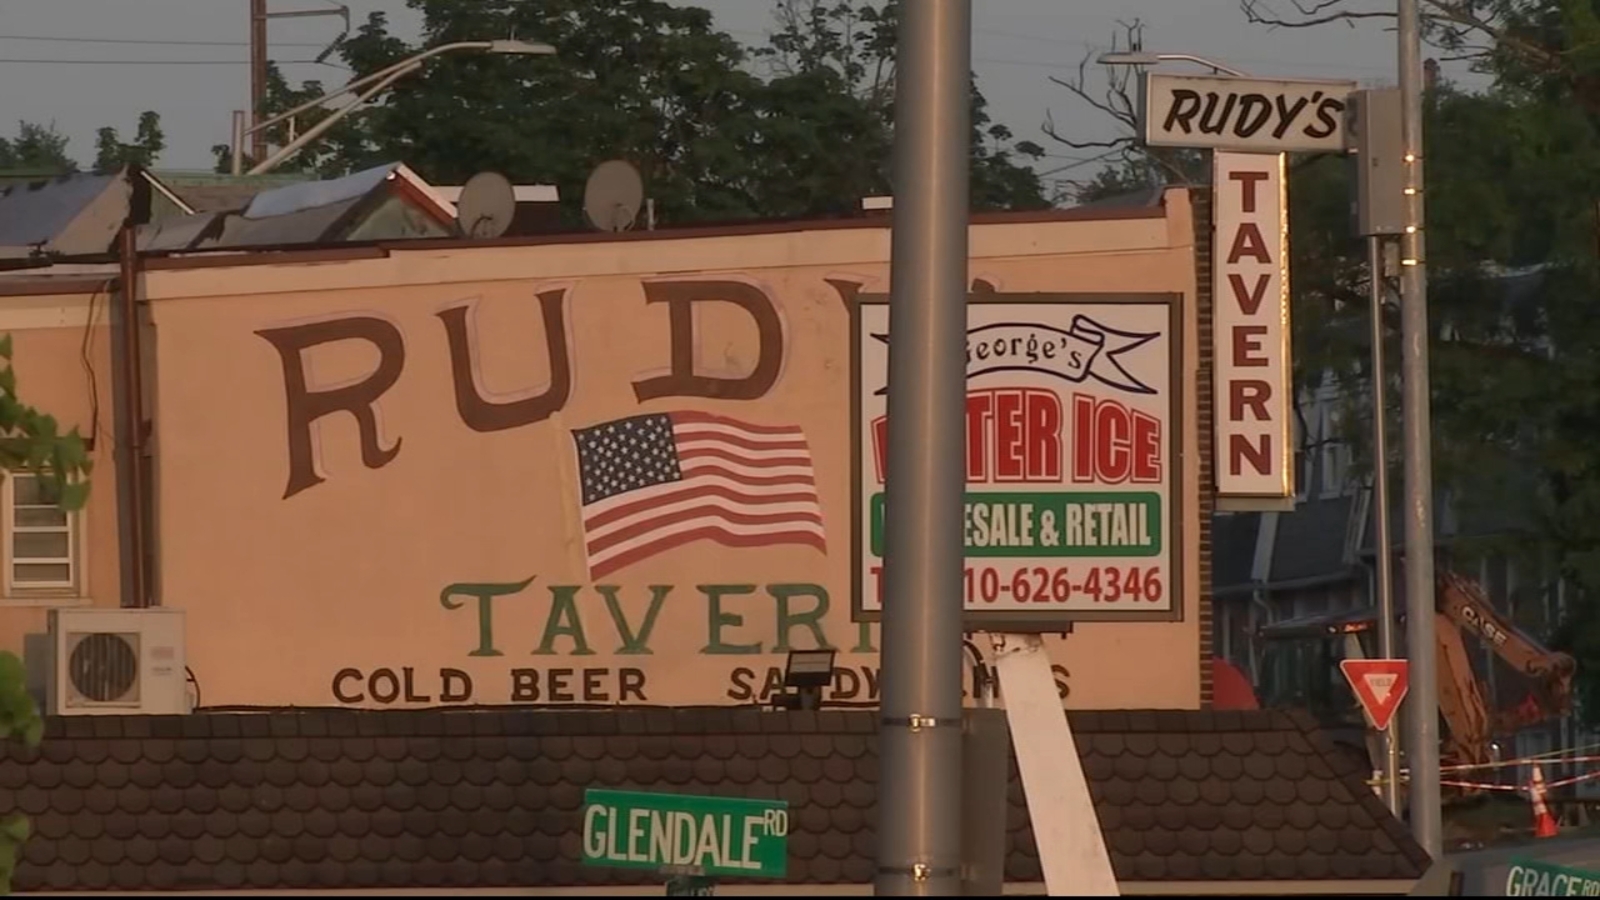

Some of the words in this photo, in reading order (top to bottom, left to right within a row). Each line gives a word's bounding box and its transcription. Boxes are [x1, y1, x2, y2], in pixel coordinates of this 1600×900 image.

[1163, 88, 1345, 140] RUDY'S
[1227, 171, 1272, 476] TAVERN
[966, 333, 1082, 370] eorge's
[253, 277, 995, 500] RUD
[870, 387, 1064, 484] TER
[1071, 392, 1162, 484] ICE
[1040, 510, 1060, 546] &
[1066, 502, 1151, 546] RETAIL
[964, 566, 1163, 603] 10-626-4346
[440, 575, 879, 657] TAVER
[1462, 605, 1507, 646] CASE
[331, 667, 473, 704] COLD
[511, 667, 648, 702] BEER
[583, 804, 763, 869] GLENDALE
[763, 809, 788, 837] RD
[1505, 865, 1582, 897] GRACE
